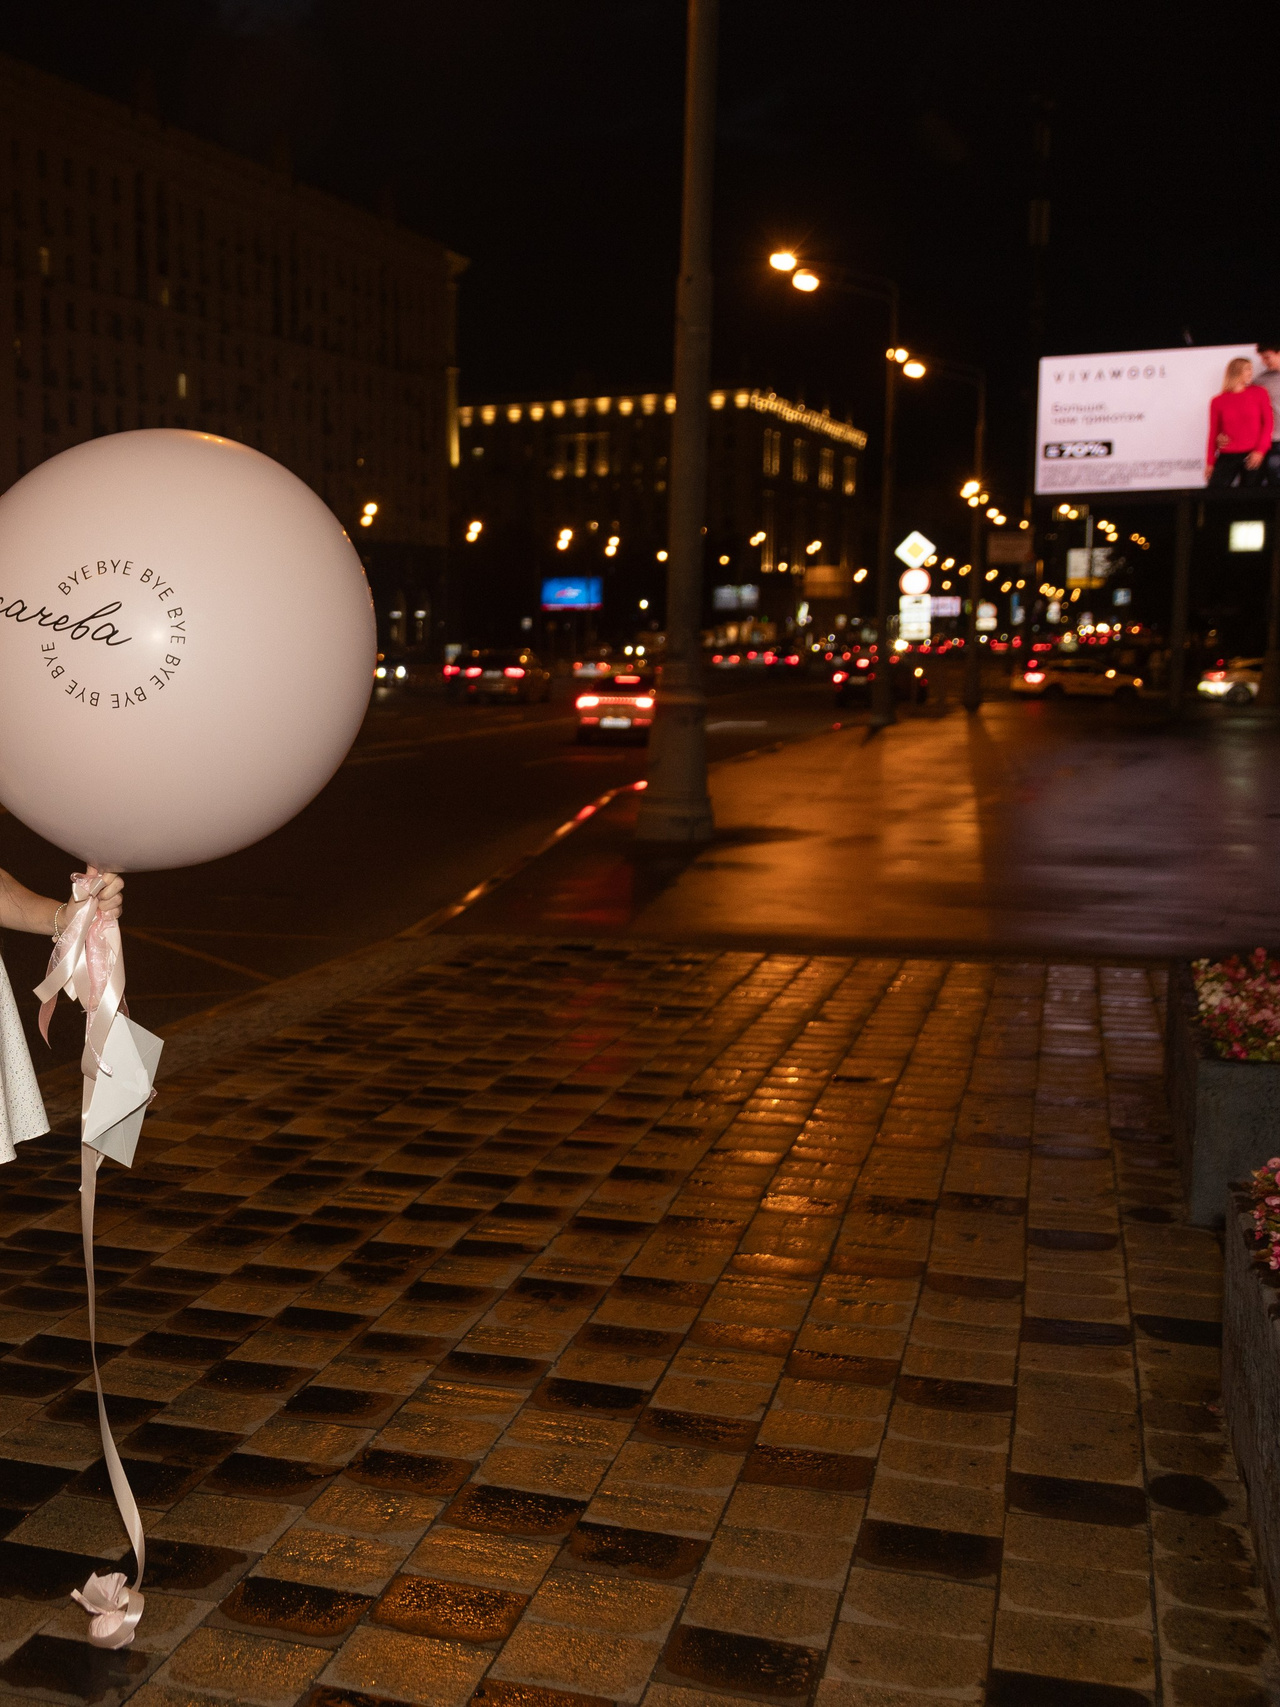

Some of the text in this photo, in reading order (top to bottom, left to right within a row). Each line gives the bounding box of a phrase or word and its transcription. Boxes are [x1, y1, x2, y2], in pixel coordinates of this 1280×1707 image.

[41, 559, 186, 709] BYE BYE BYE BYE BYE BYE BYE BYE
